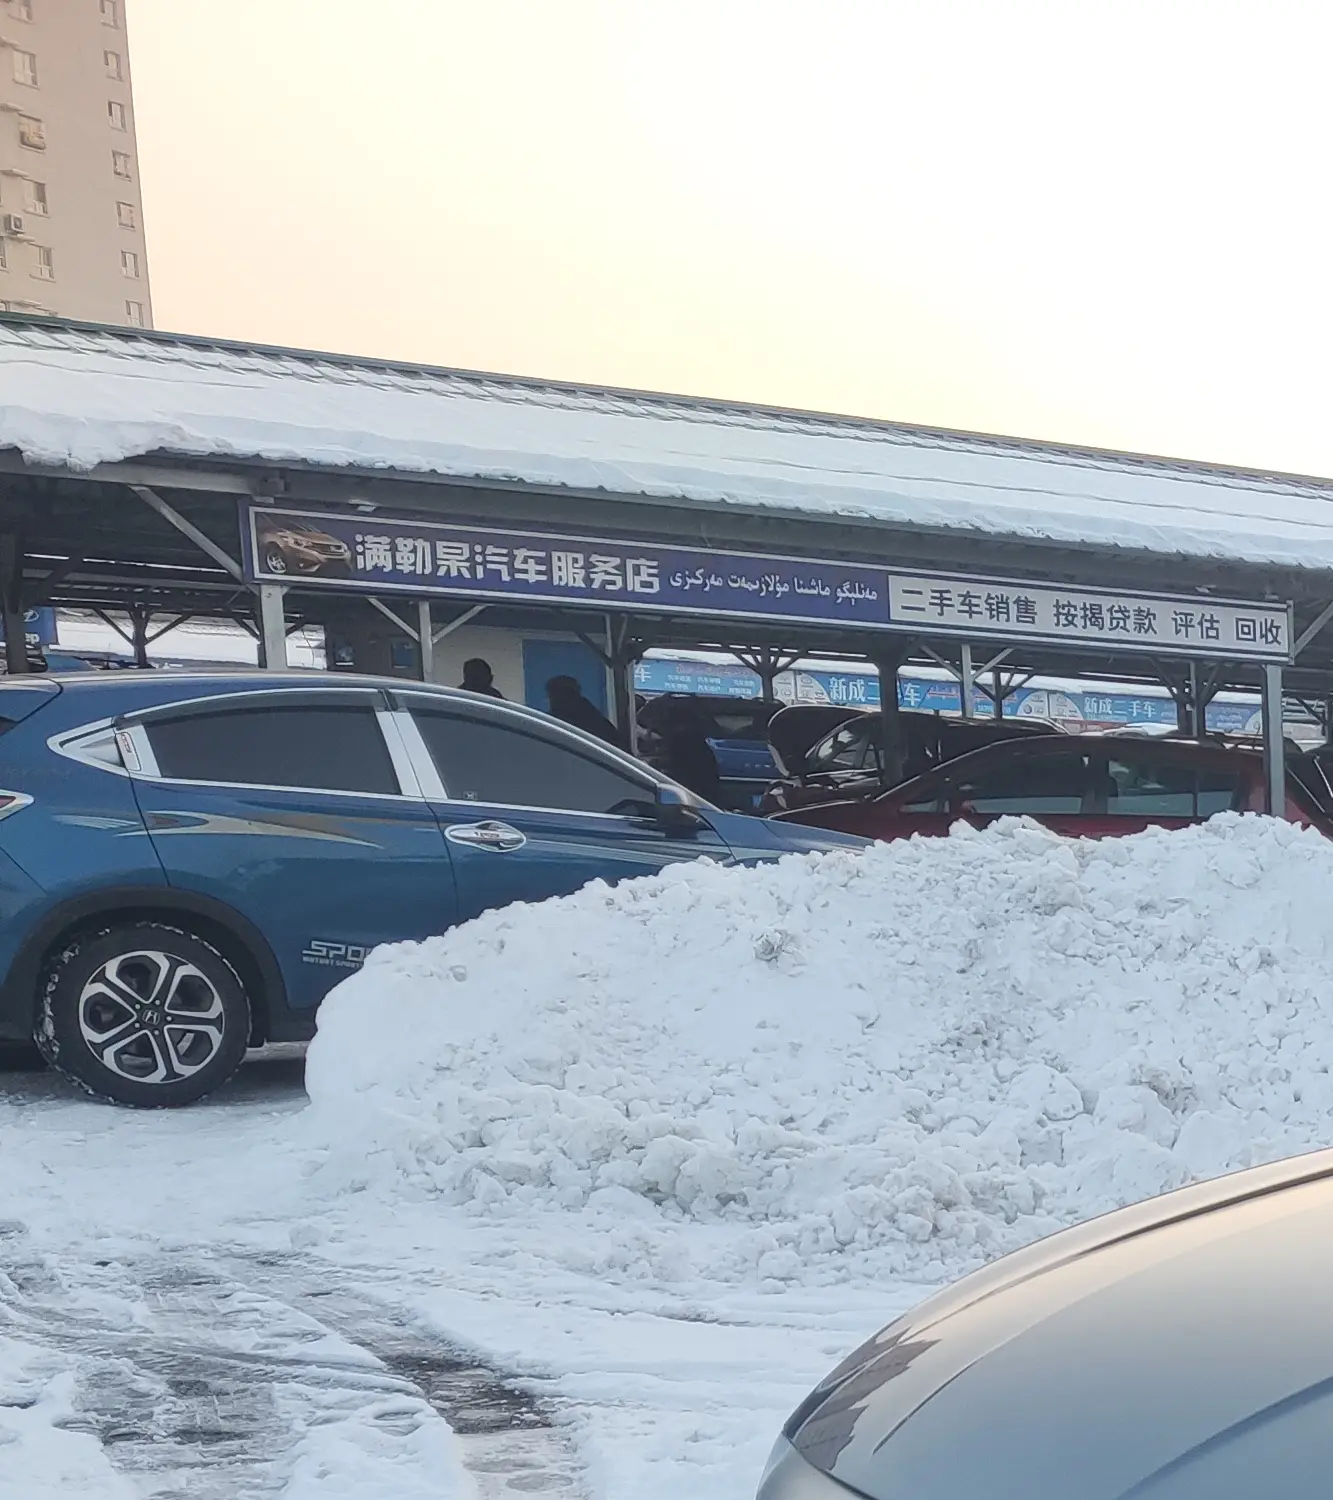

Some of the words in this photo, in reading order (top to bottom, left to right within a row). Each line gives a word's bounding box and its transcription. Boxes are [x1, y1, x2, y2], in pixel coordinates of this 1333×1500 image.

[900, 588, 1038, 625] 二手车销售
[1053, 599, 1158, 635] 按揭贷款
[1171, 610, 1221, 641] 评估
[1235, 617, 1282, 646] 回收
[829, 677, 922, 706] 新成二车
[1083, 696, 1157, 718] 新成二手车
